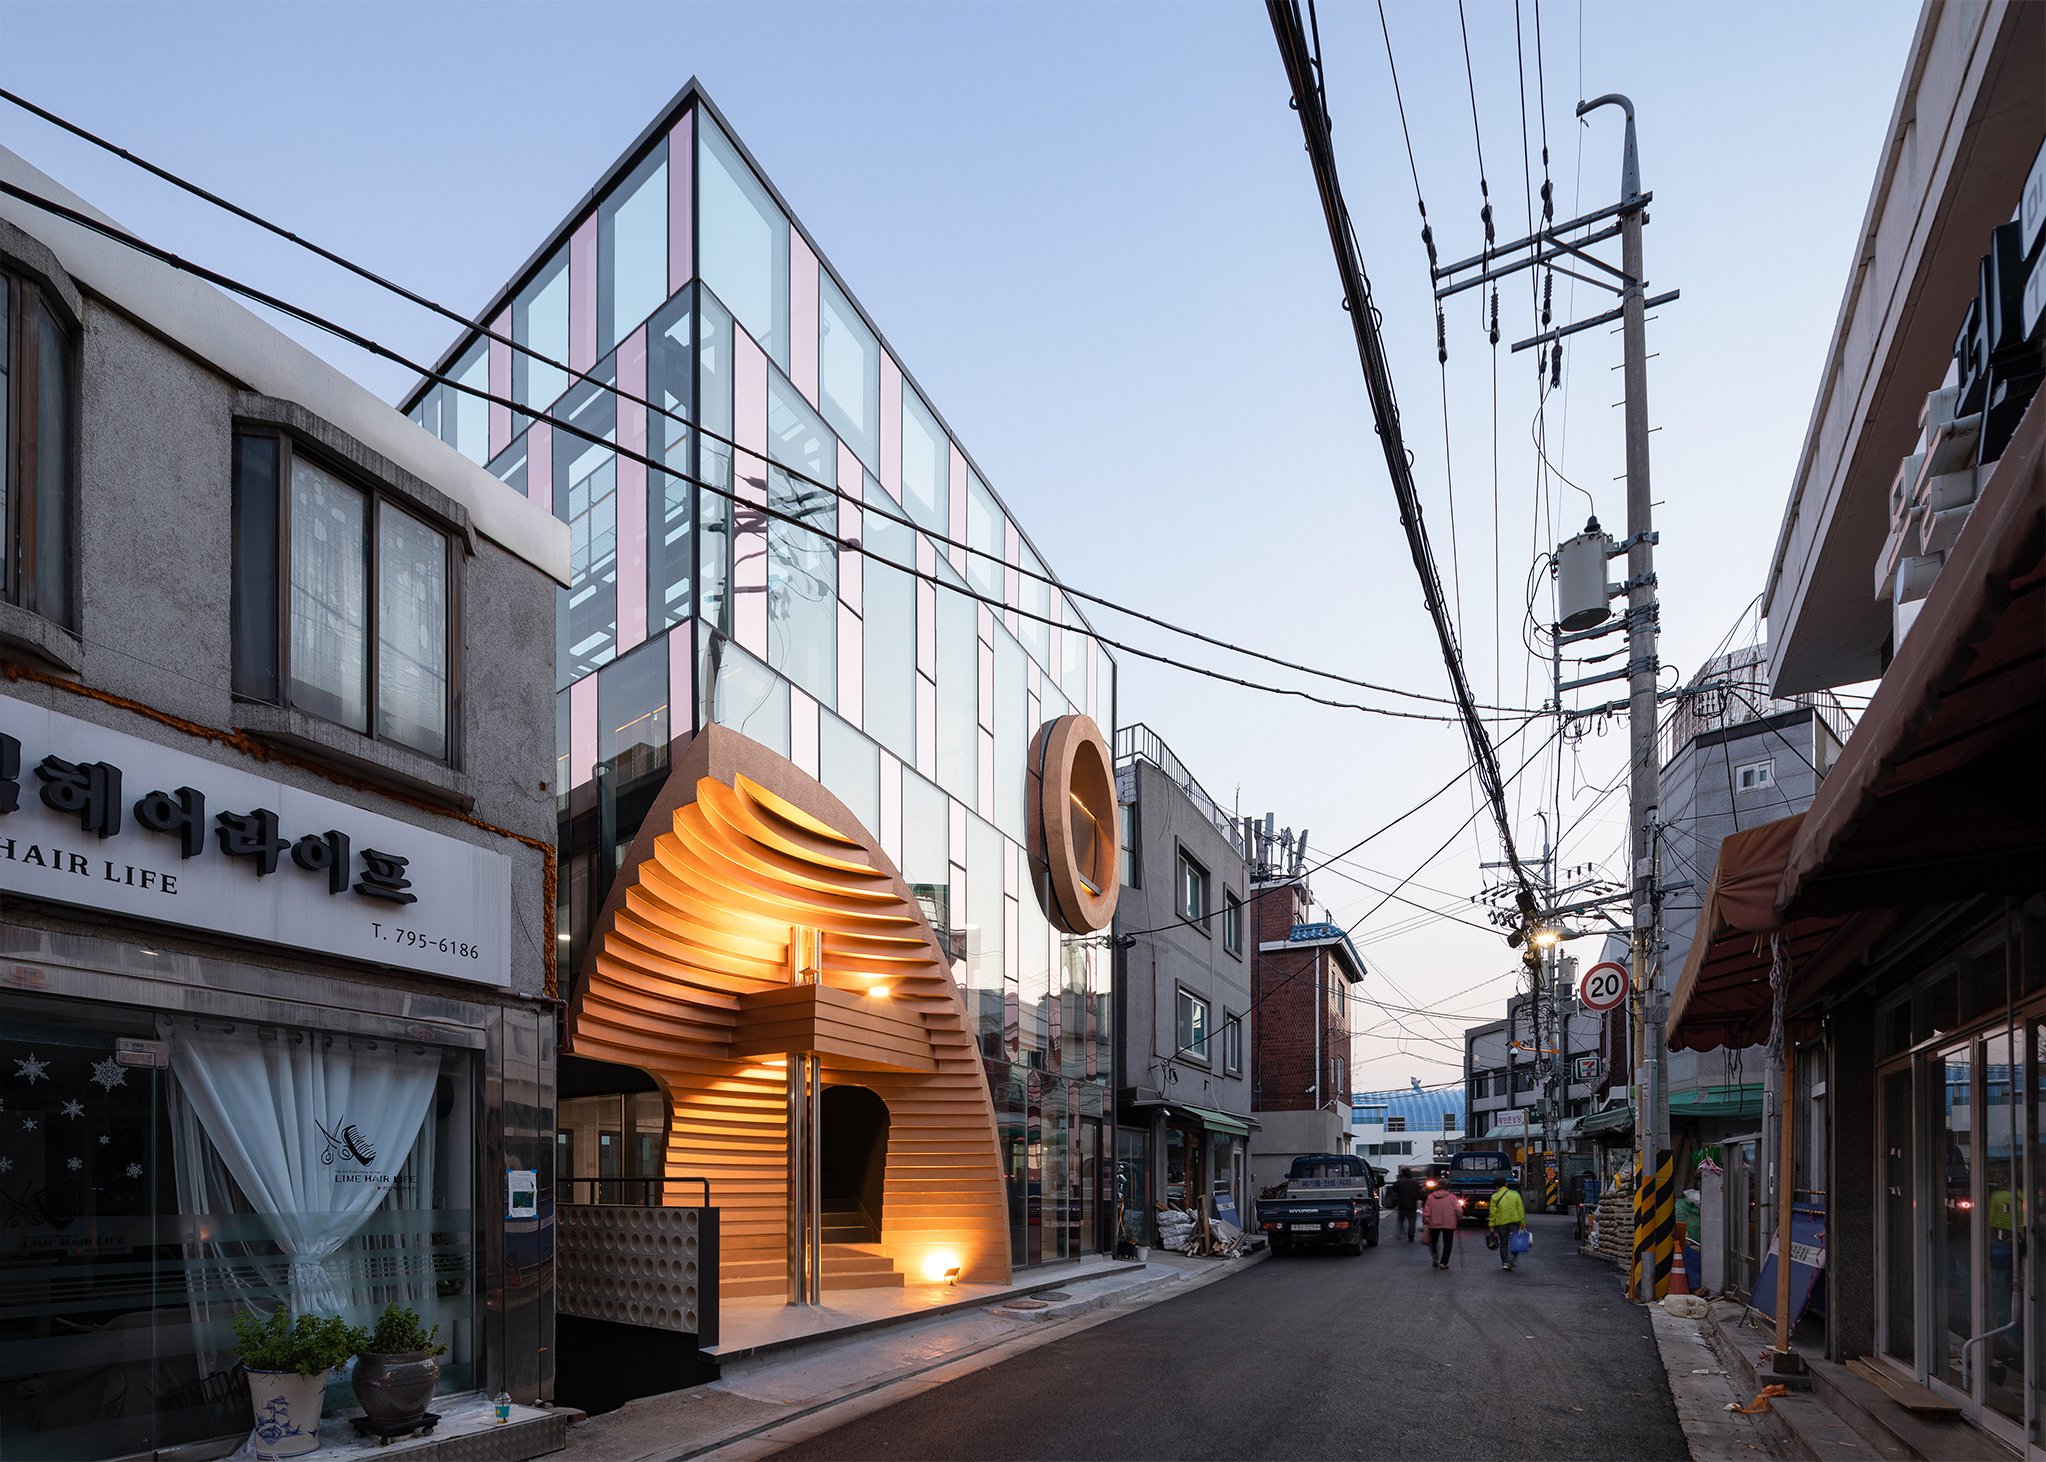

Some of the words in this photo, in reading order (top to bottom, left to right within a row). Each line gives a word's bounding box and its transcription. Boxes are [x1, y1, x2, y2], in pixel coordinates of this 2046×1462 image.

[0, 731, 418, 905] 헤어라이프
[103, 860, 178, 895] LIFE
[372, 922, 387, 941] T.
[396, 928, 479, 959] 795-6186
[1591, 973, 1620, 998] 20
[335, 1175, 361, 1183] LIME
[364, 1175, 390, 1183] HAIR
[393, 1175, 416, 1184] LIFE
